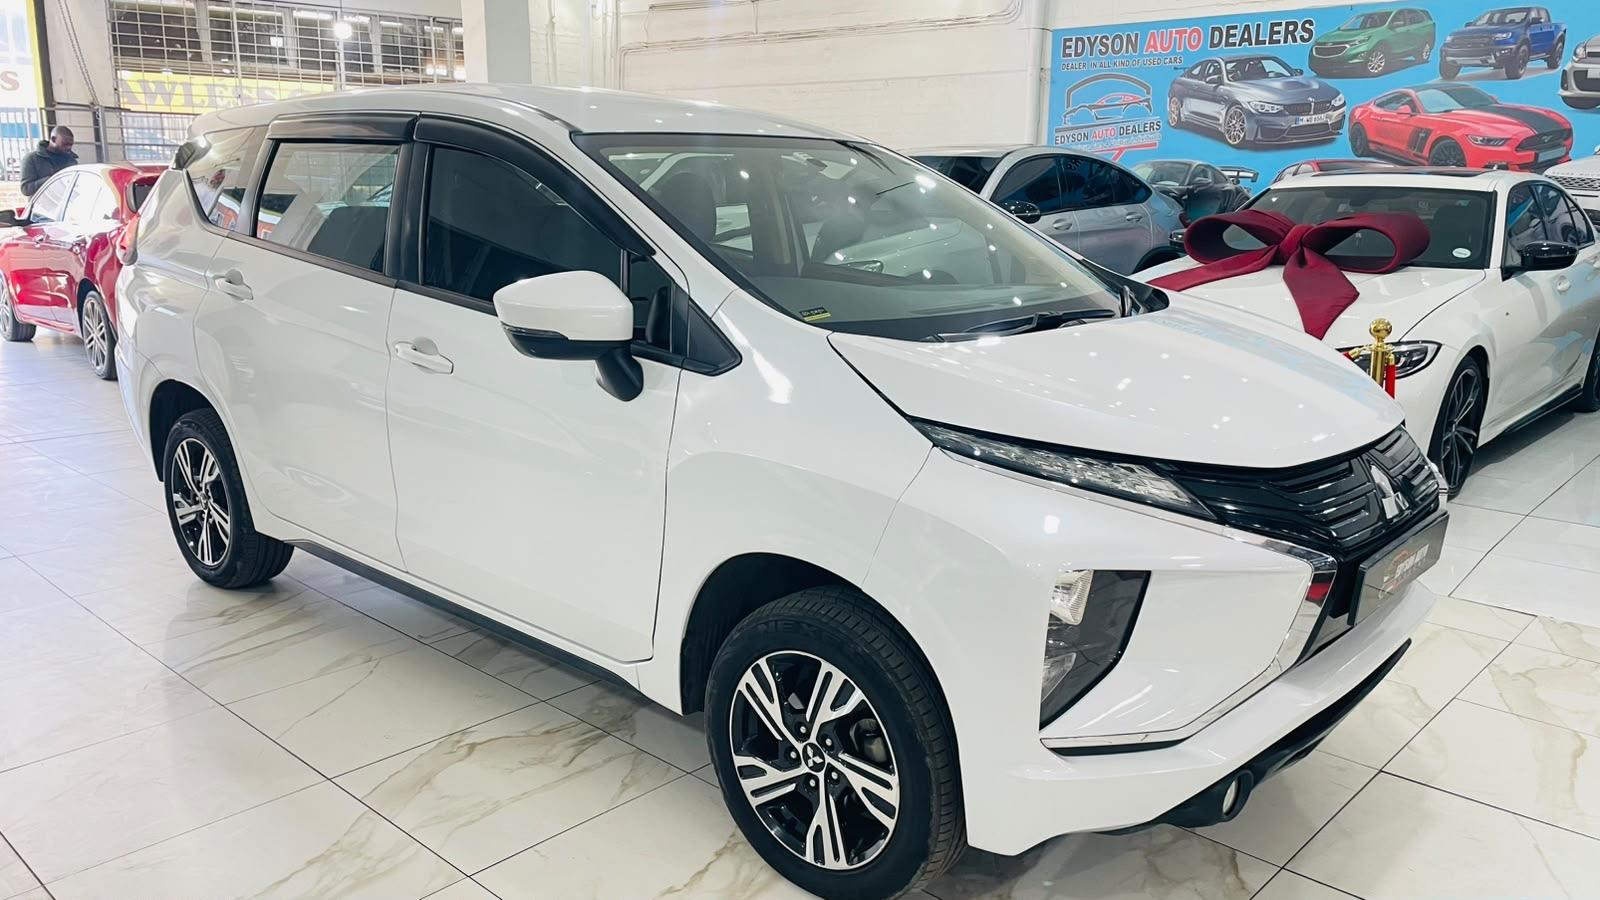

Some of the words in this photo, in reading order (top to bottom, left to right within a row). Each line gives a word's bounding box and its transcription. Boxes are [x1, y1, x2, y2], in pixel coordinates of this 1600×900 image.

[1062, 33, 1139, 58] EDYSON
[1145, 28, 1203, 52] AUTO
[1209, 19, 1314, 49] DEALERS
[1061, 61, 1088, 71] DEALER
[1090, 61, 1098, 69] IN
[1099, 60, 1112, 68] ALL
[1114, 59, 1131, 68] KIND
[1132, 58, 1141, 67] OF
[1143, 57, 1162, 66] USED
[1163, 56, 1183, 65] CARS
[1055, 131, 1089, 145] EDYSON
[1091, 127, 1116, 140] AUTO
[1119, 120, 1162, 136] DEALERS
